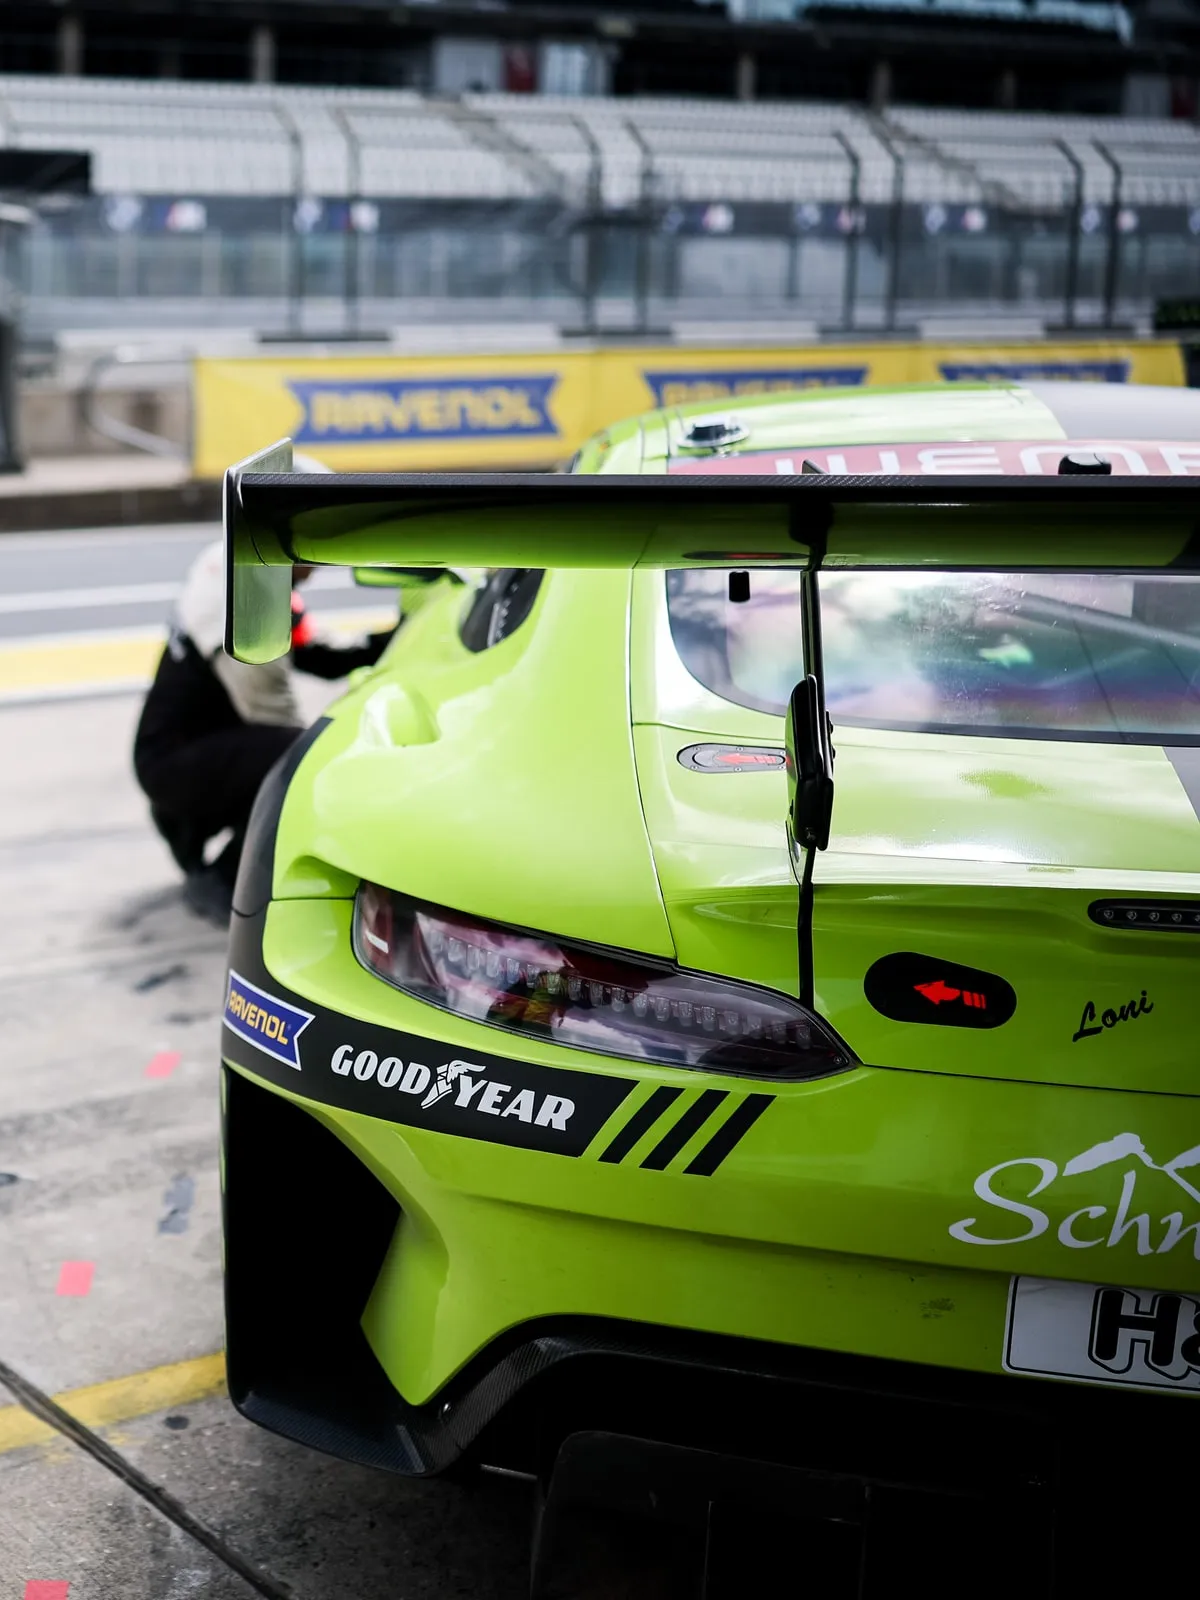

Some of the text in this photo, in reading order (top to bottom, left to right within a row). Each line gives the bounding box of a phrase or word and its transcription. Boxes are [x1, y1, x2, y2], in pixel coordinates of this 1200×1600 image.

[310, 389, 542, 434] RAVENOL
[228, 990, 289, 1046] RAVENOL
[1072, 990, 1155, 1043] Loni
